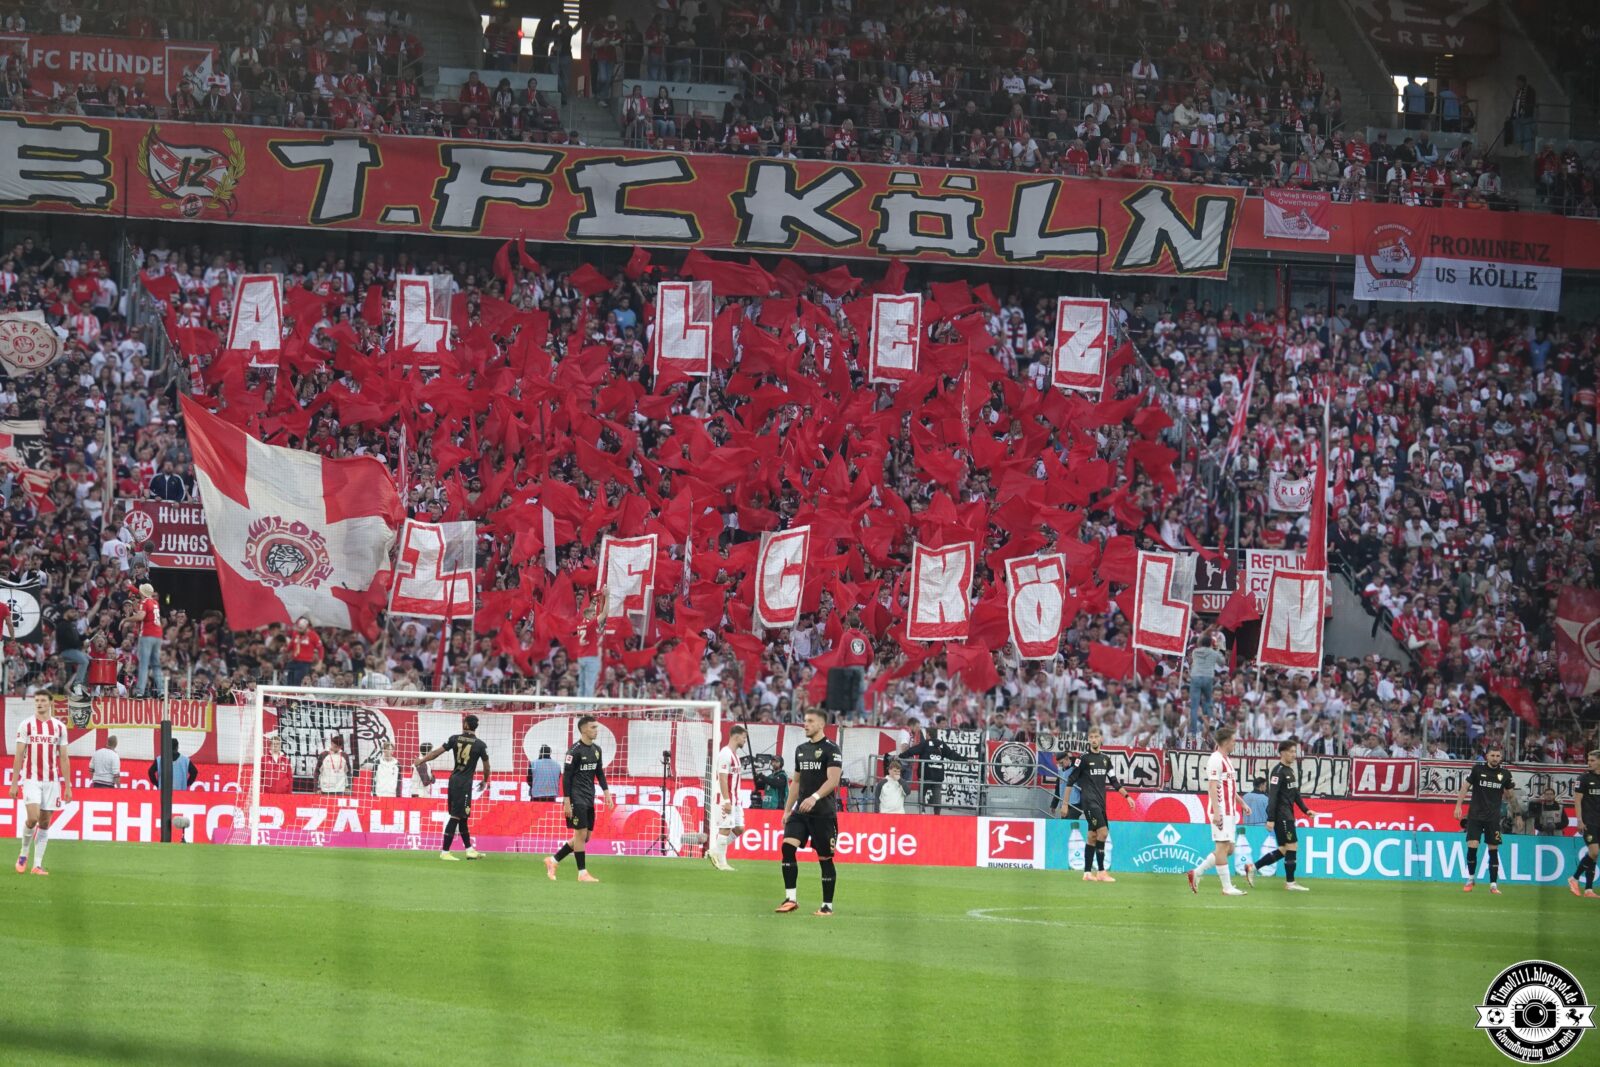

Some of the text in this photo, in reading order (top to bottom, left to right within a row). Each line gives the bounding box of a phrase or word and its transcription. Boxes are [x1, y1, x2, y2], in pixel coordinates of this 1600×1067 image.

[1370, 26, 1465, 49] CREW
[33, 48, 164, 75] FC FRÜNDE
[730, 158, 1240, 275] KÖLN
[1430, 234, 1550, 263] PROMINENZ
[1435, 263, 1539, 291] US KÖLLE
[158, 534, 209, 553] JUNGS
[92, 696, 208, 729] STADIONVRBOT
[30, 735, 53, 744] REWE
[457, 742, 472, 765] 14
[1358, 763, 1412, 793] AJJ
[55, 797, 61, 808] 6
